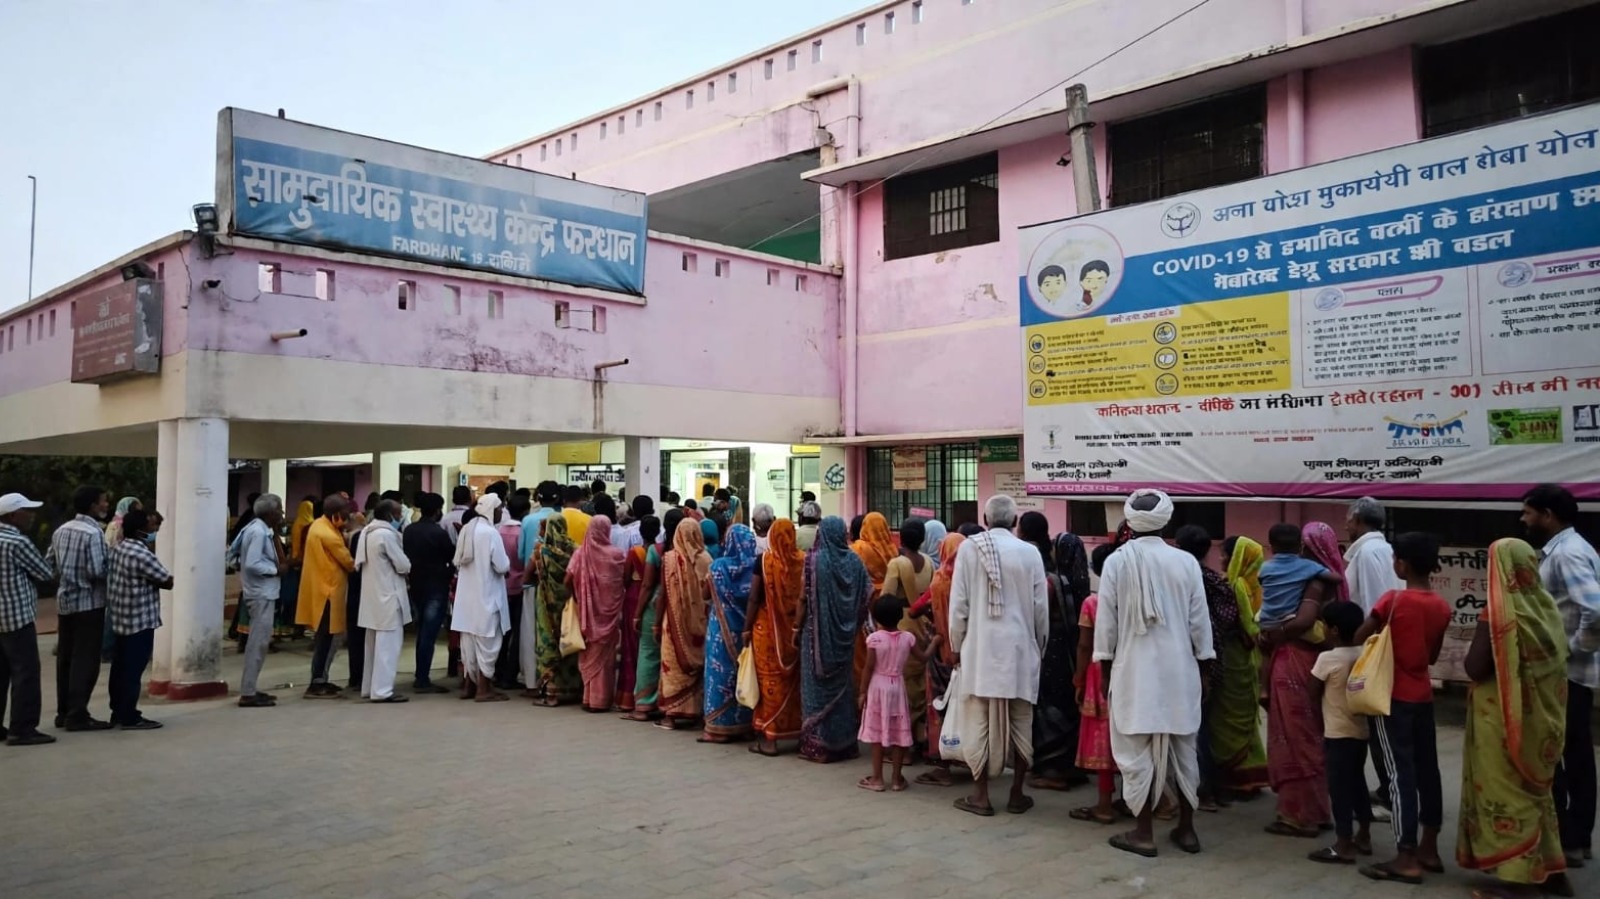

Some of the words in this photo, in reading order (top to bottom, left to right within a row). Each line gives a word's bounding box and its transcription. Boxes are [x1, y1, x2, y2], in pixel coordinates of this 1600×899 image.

[1418, 156, 1469, 181] बाल
[241, 159, 404, 230] सामुदायिक
[410, 190, 499, 242] स्वास्थ्य
[503, 198, 558, 258] केन्द्र
[561, 219, 637, 266] फरधान
[1152, 248, 1249, 276] COVID-19
[1431, 206, 1458, 229] के
[1326, 247, 1401, 274] सरकार
